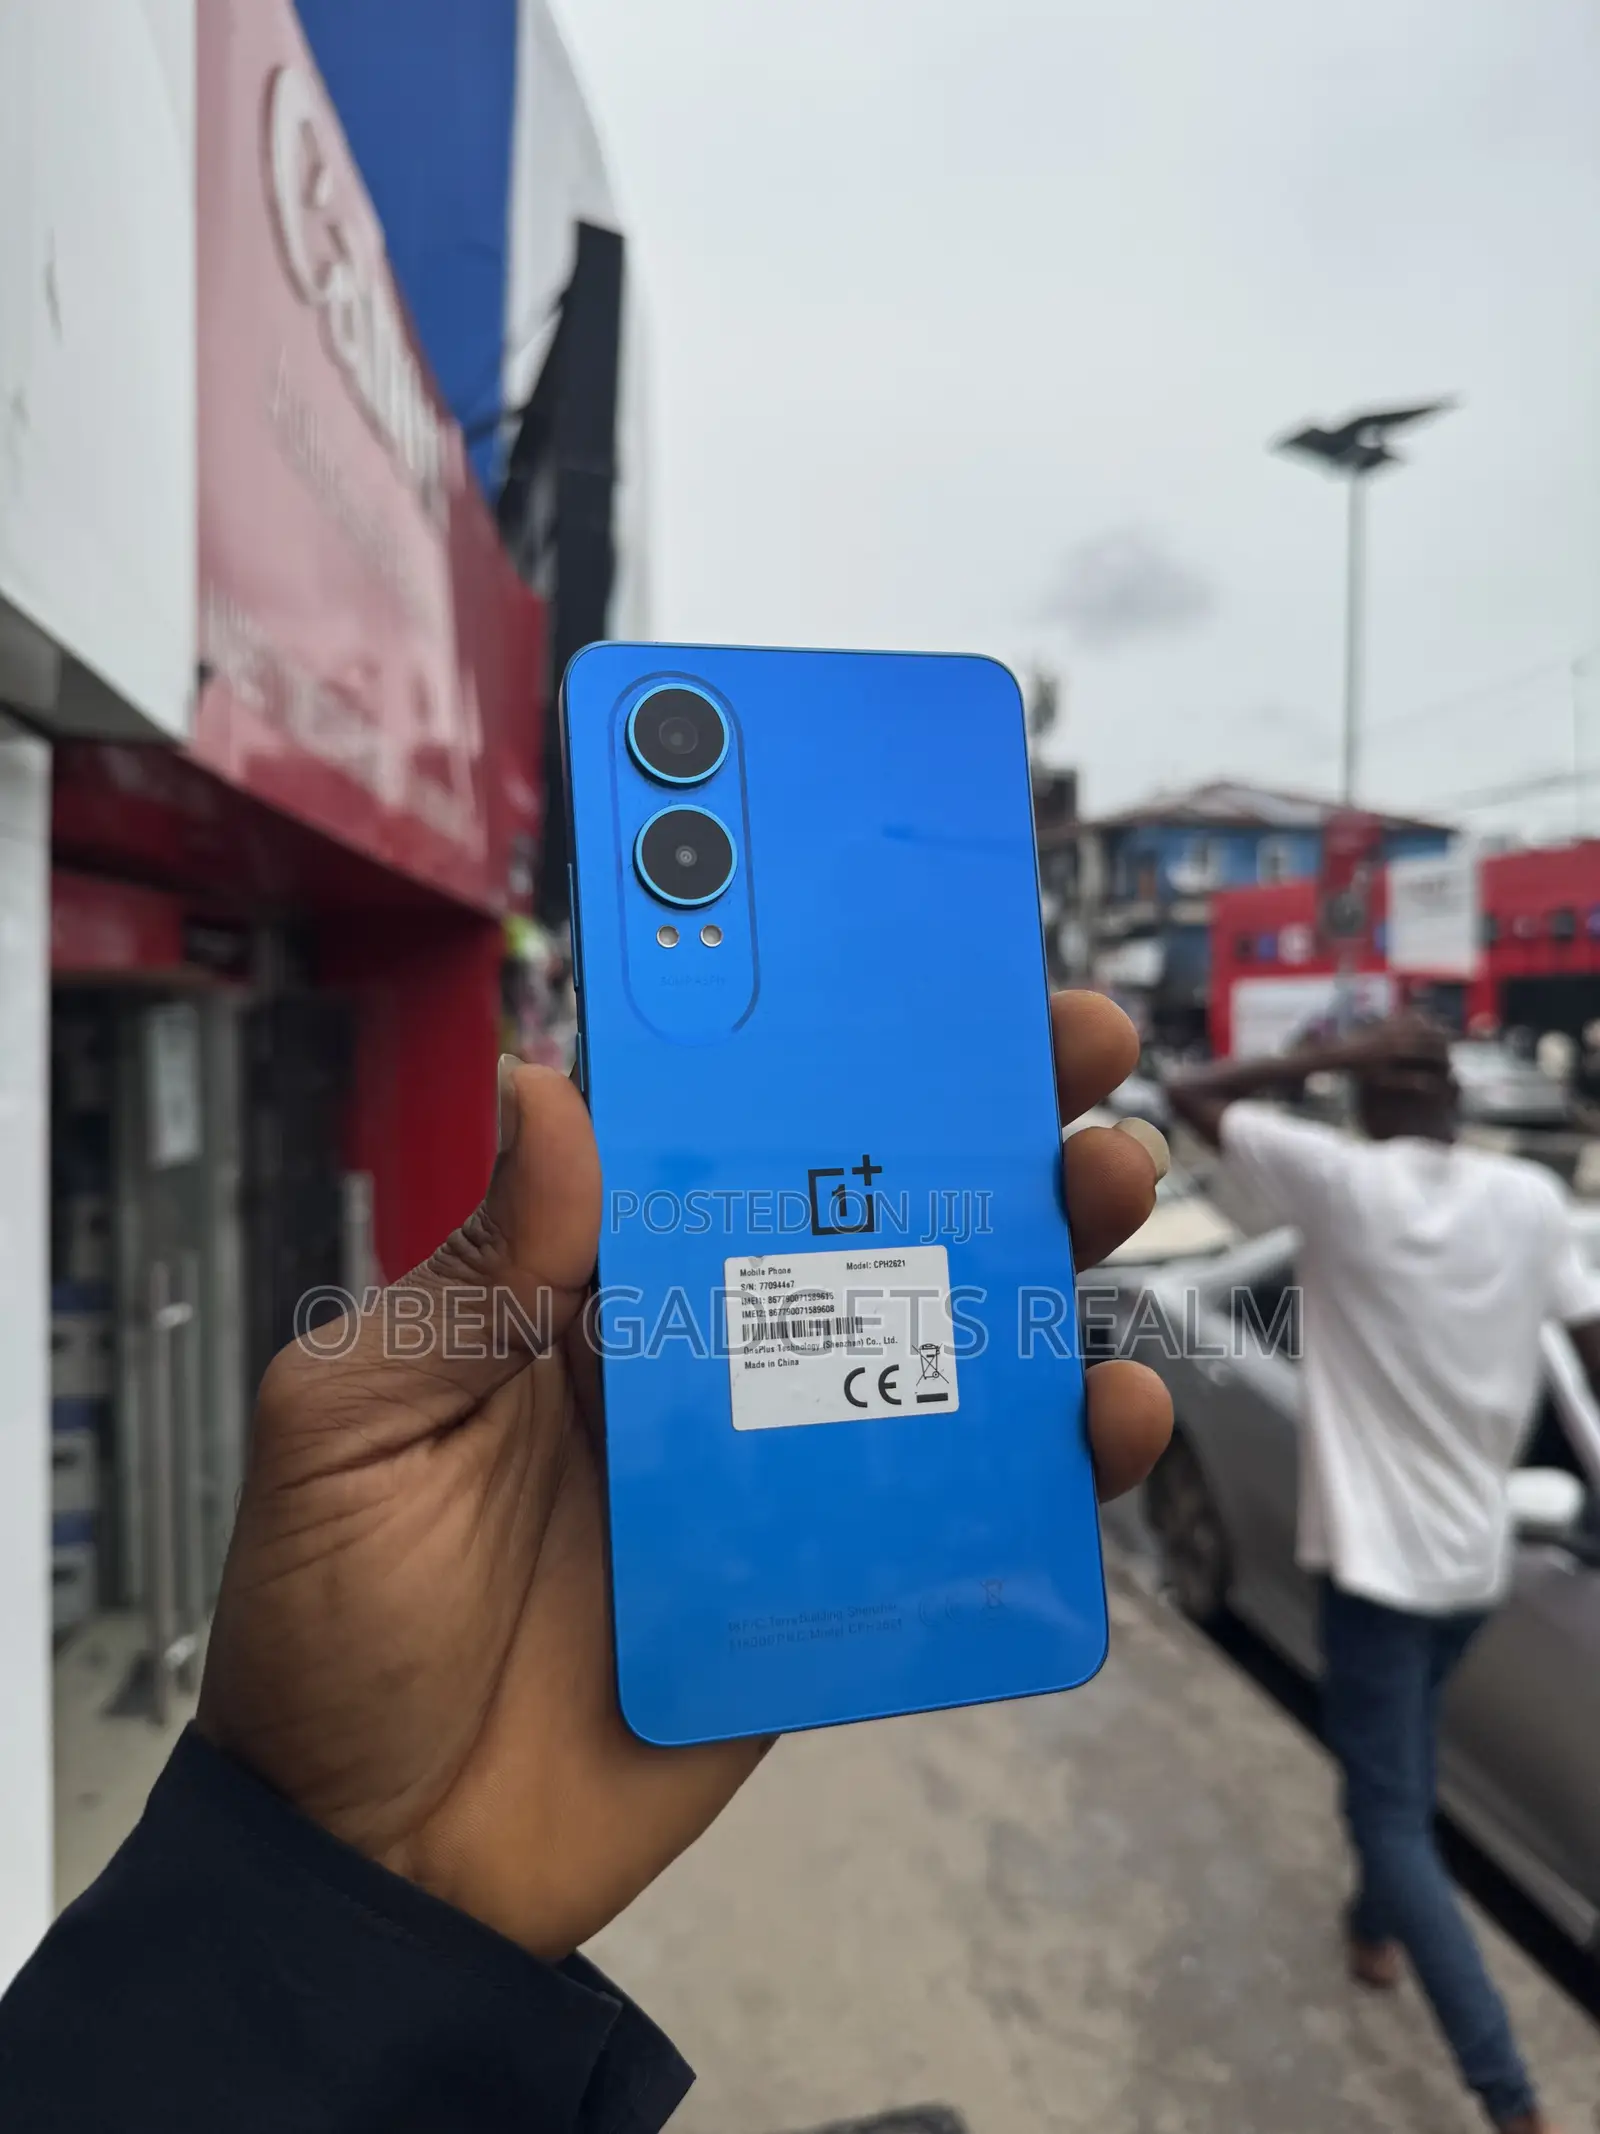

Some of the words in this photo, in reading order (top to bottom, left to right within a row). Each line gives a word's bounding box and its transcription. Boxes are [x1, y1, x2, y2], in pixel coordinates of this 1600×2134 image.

[846, 1261, 872, 1271] Model:
[873, 1259, 906, 1269] CPH2621
[740, 1268, 766, 1277] Mobile
[768, 1266, 792, 1276] Phone
[741, 1283, 757, 1291] S/N:
[883, 1336, 898, 1345] Ltd.
[744, 1360, 765, 1370] Made
[768, 1359, 775, 1368] in
[777, 1357, 800, 1368] China
[844, 1364, 902, 1408] CE
